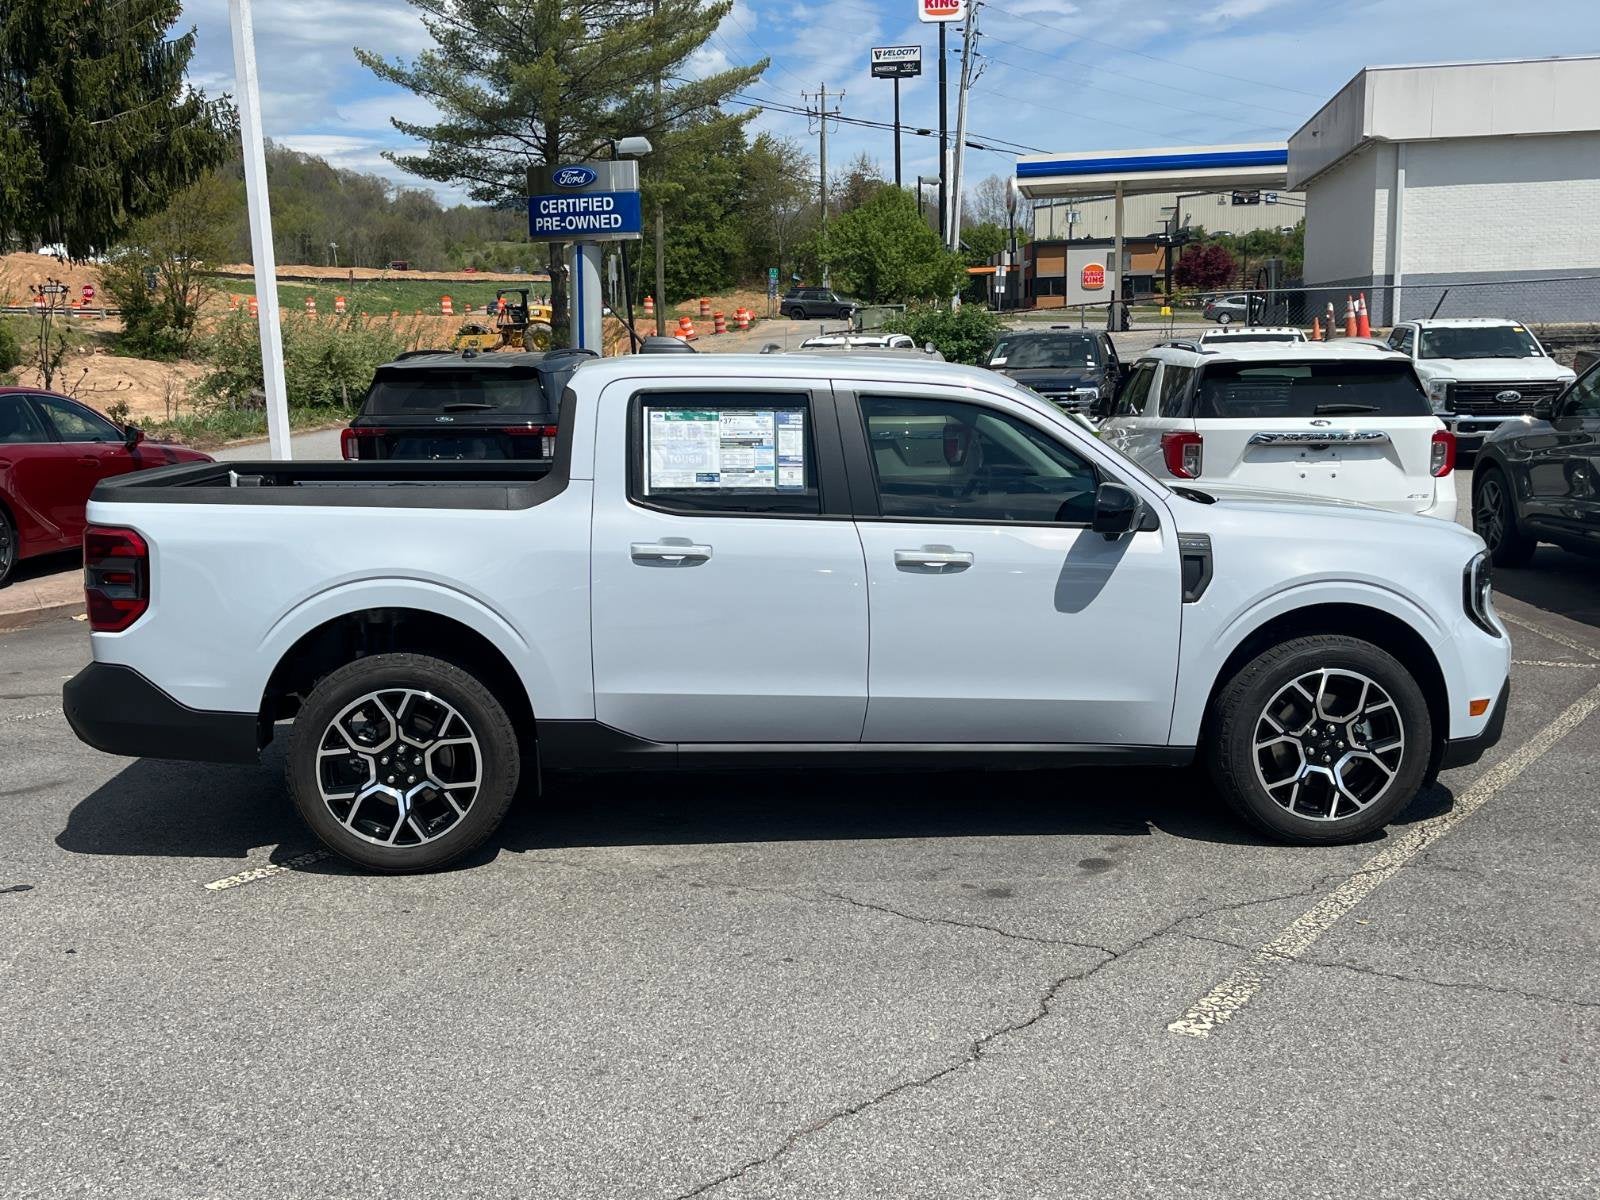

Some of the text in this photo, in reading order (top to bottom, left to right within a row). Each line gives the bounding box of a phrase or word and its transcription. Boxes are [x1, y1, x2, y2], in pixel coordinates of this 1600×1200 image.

[925, 0, 959, 8] KING
[560, 170, 586, 184] Ford
[540, 197, 614, 214] CERTIFIED
[536, 214, 622, 231] PRE-OWNED
